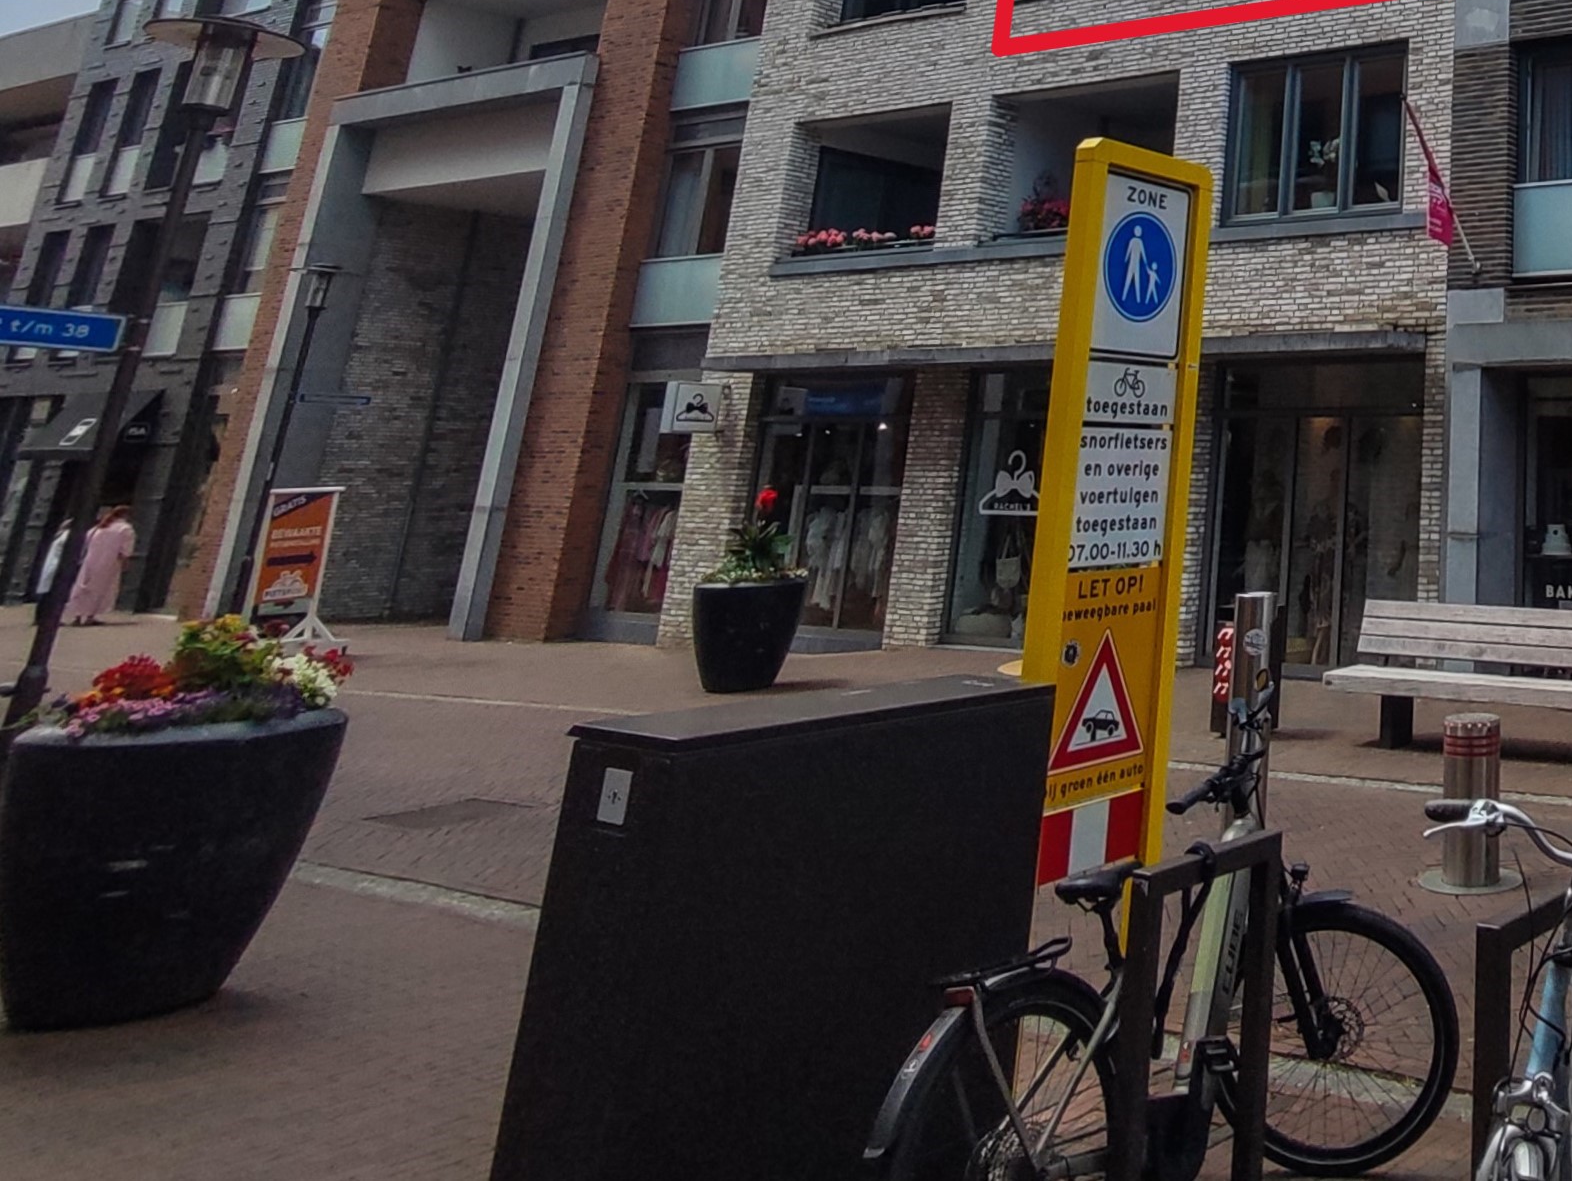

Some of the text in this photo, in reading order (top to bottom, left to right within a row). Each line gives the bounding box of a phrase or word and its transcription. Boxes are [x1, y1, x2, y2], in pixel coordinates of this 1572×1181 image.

[1126, 185, 1168, 210] ZONE
[11, 319, 90, 338] t/m 38
[1086, 396, 1168, 419] toegestaan
[1080, 433, 1168, 450] snorfietsers
[1084, 460, 1159, 481] en overige
[1080, 486, 1158, 508] voertuigen
[1076, 514, 1157, 537] toegestaan
[1153, 540, 1161, 556] h
[1078, 574, 1144, 599] LET OP!
[1133, 598, 1156, 615] paal
[1047, 764, 1144, 803] ij groen één auto
